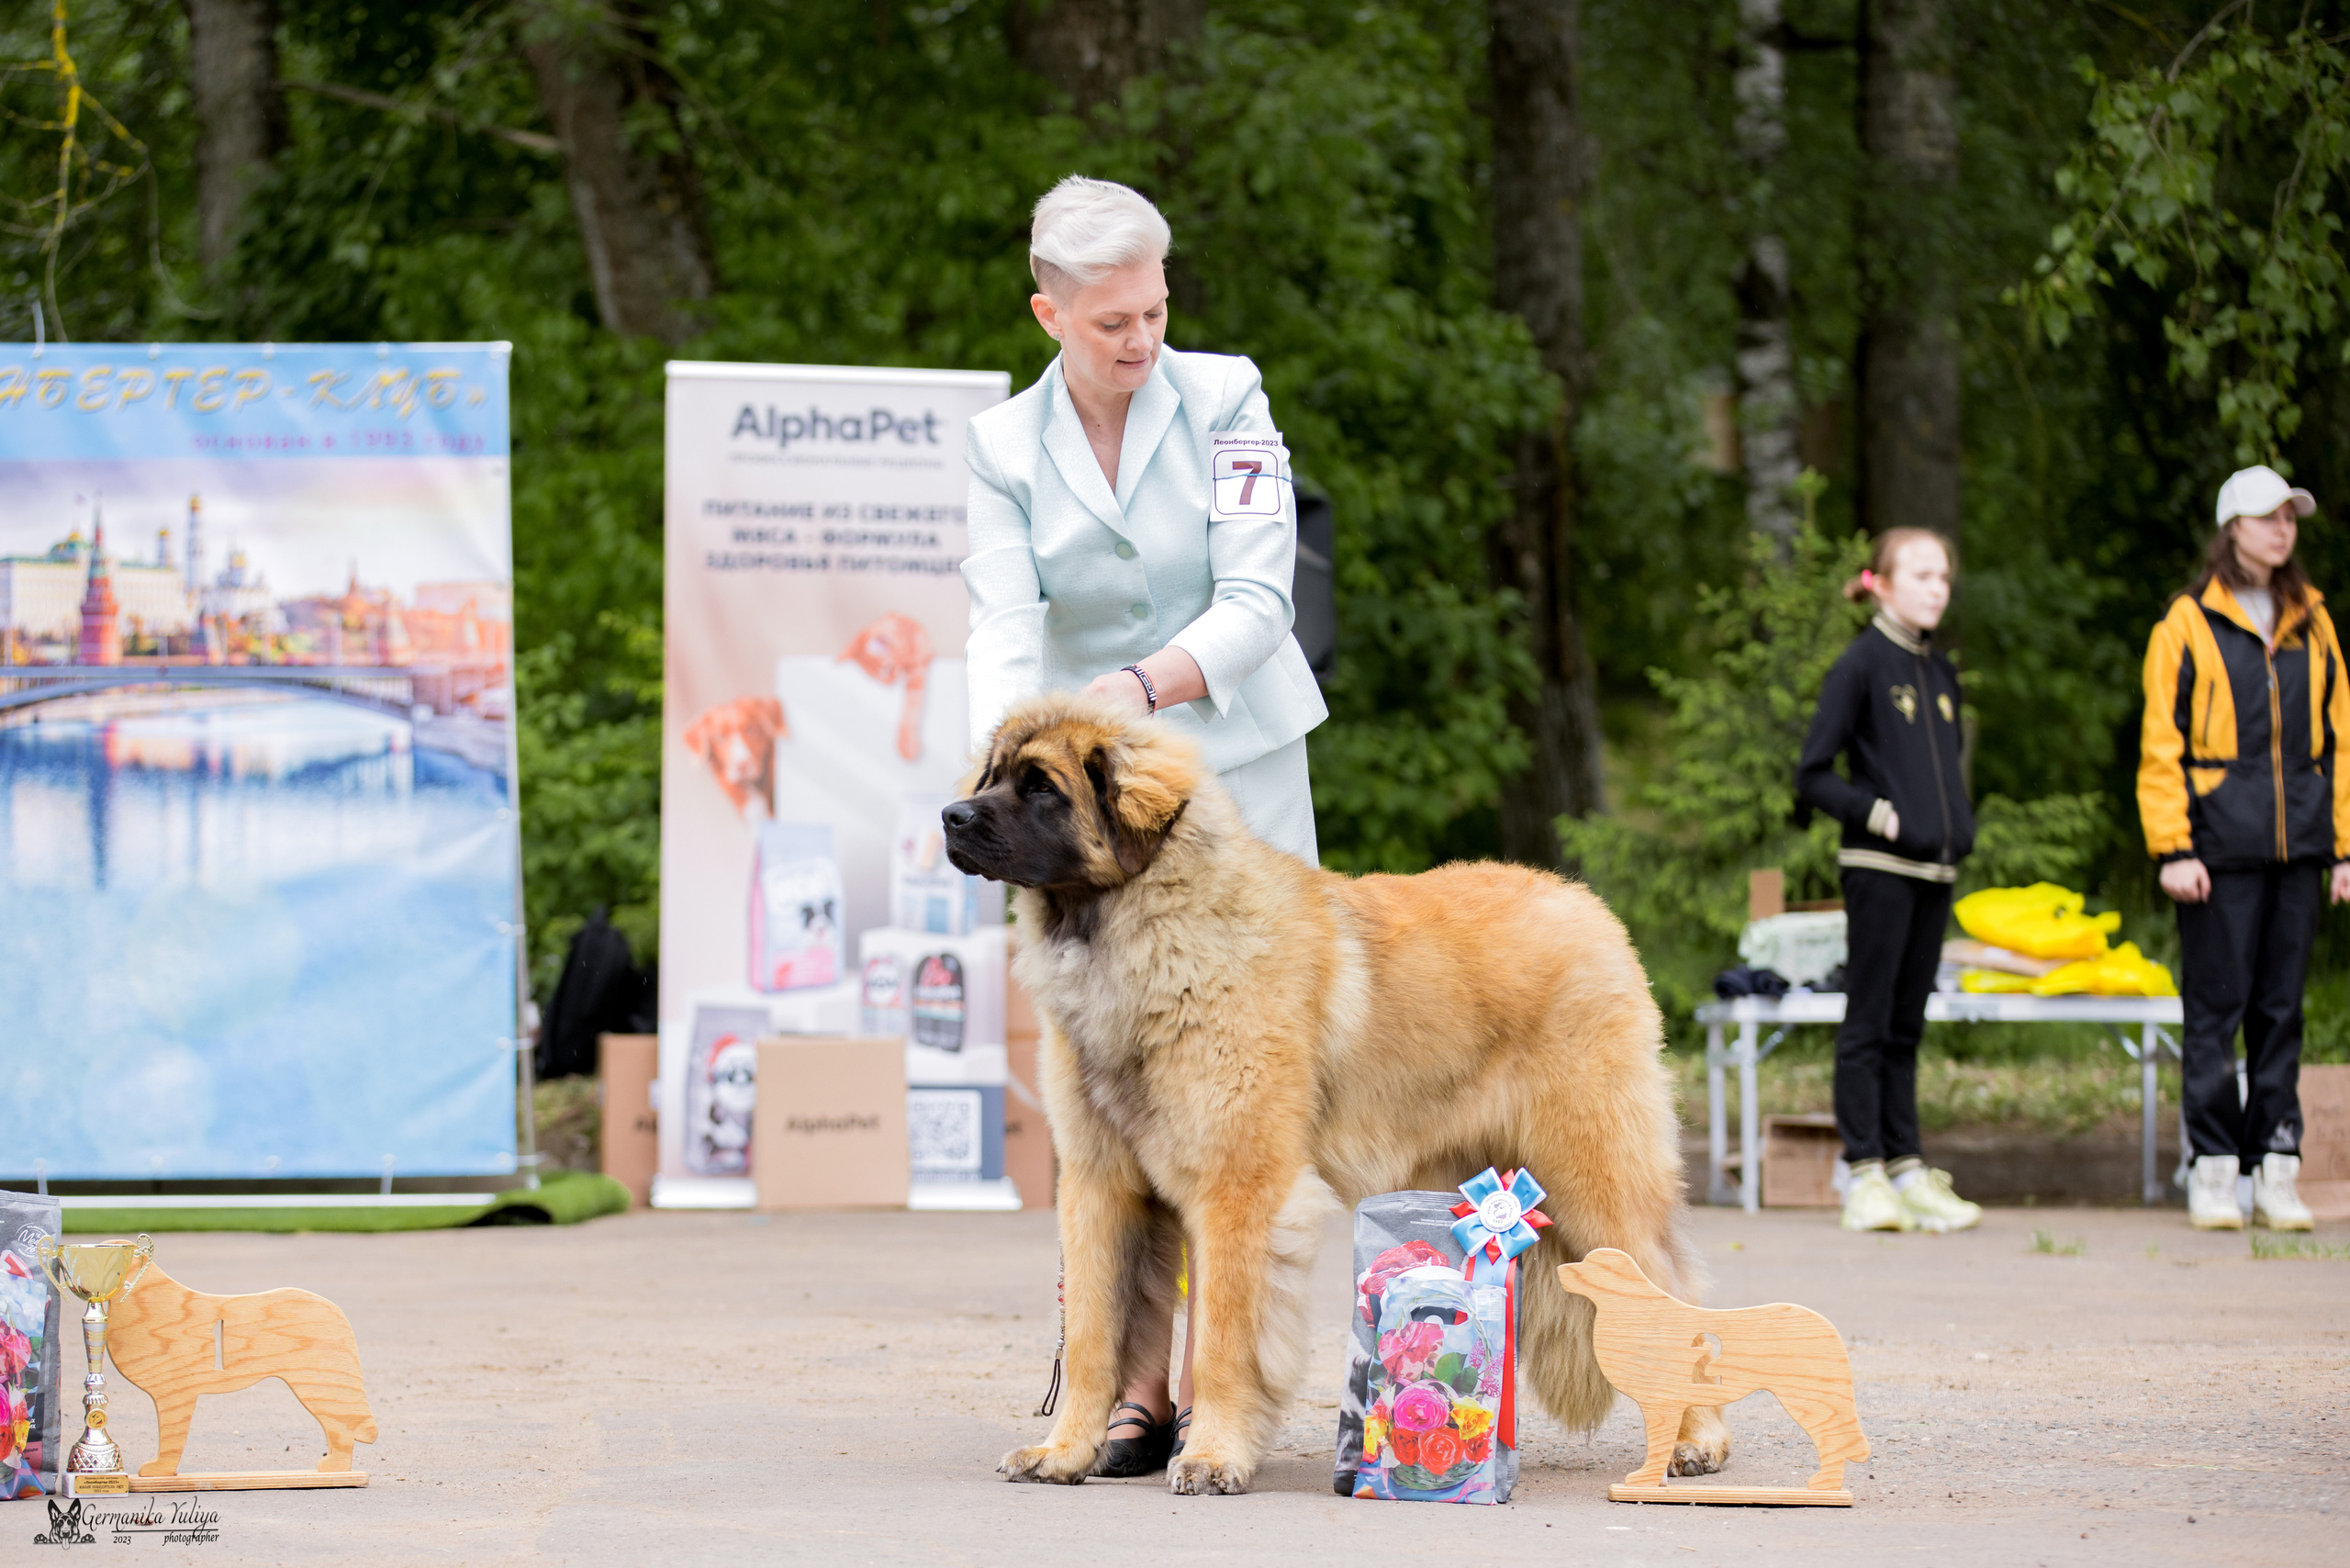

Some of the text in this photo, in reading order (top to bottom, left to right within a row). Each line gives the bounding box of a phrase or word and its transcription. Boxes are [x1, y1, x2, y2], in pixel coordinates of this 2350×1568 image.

[732, 404, 943, 449] AlphaPet
[1232, 461, 1262, 505] 7
[703, 499, 814, 519] ПИТАНИЕ
[837, 554, 961, 576] ПИТОМЦЕ
[785, 1114, 879, 1136] AlphaPet
[211, 1318, 224, 1370] 1
[1690, 1332, 1722, 1384] 2
